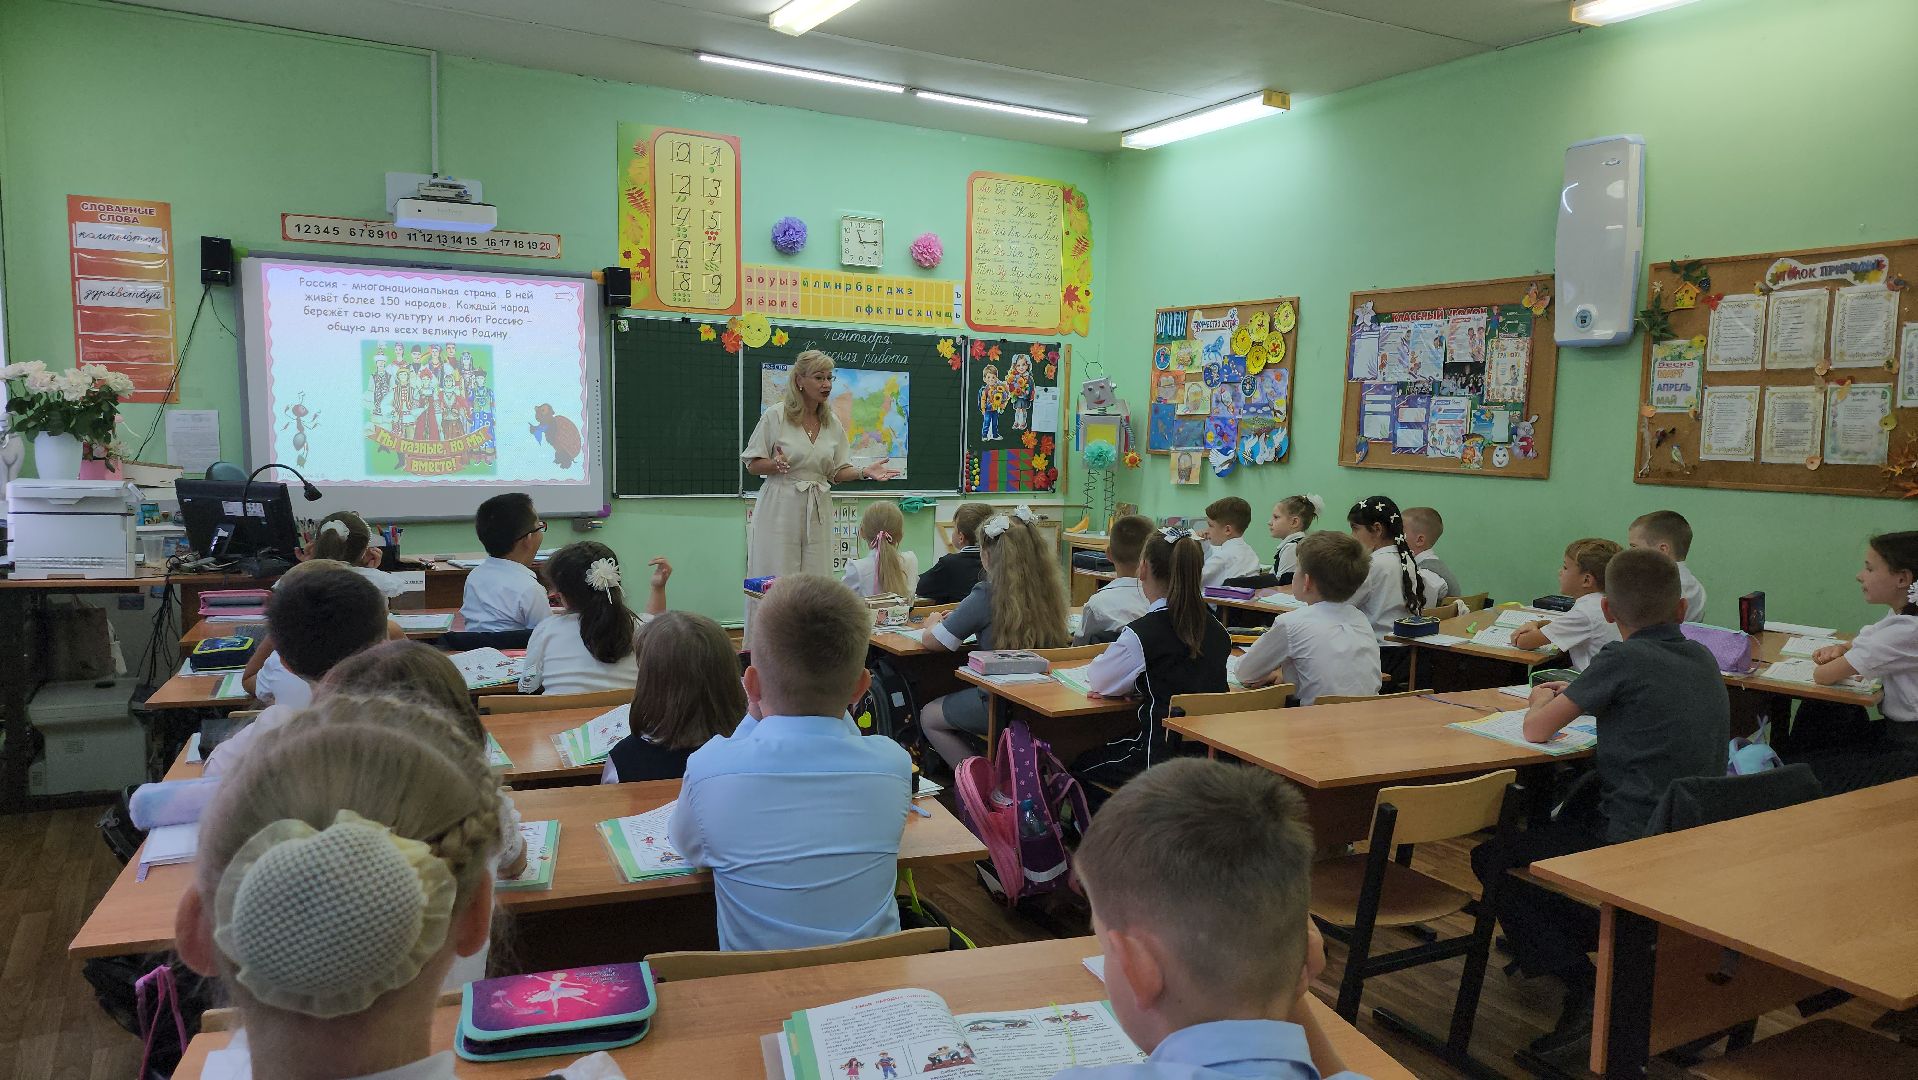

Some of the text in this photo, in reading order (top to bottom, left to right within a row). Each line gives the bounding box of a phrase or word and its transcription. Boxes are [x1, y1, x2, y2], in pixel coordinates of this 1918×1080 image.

[677, 143, 720, 165] 0 1
[679, 176, 721, 197] 2 3
[81, 203, 156, 216] СЛОВАРНЫЕ
[99, 214, 140, 223] СЛОВА
[677, 208, 721, 229] 4 5
[295, 224, 551, 251] 1 2 3 4 5 6 7 8 9 10 11 12 13 14 15 16 17 18 19 20
[678, 241, 721, 261] 6 7
[299, 277, 338, 288] Россия
[352, 282, 459, 295] многонациональная
[505, 290, 512, 298] В
[516, 291, 534, 300] ней
[680, 272, 721, 293] 8 9
[305, 293, 338, 303] живёт
[343, 294, 375, 305] более
[381, 297, 400, 306] 150
[456, 300, 497, 311] Каждый
[501, 304, 530, 313] народ
[304, 306, 349, 318] бережёт
[385, 312, 433, 324] культуру
[448, 314, 482, 323] любит
[486, 315, 524, 325] Россию
[1391, 307, 1444, 322] КЛАССНЫЙ
[327, 322, 366, 334] общую
[370, 325, 390, 333] для
[394, 326, 419, 334] всех
[422, 327, 468, 338] великую
[862, 347, 909, 367] работа
[1656, 383, 1692, 391] АПРЕЛЬ
[1656, 394, 1677, 405] МАЙ
[841, 541, 848, 552] 9
[834, 558, 840, 568] 6
